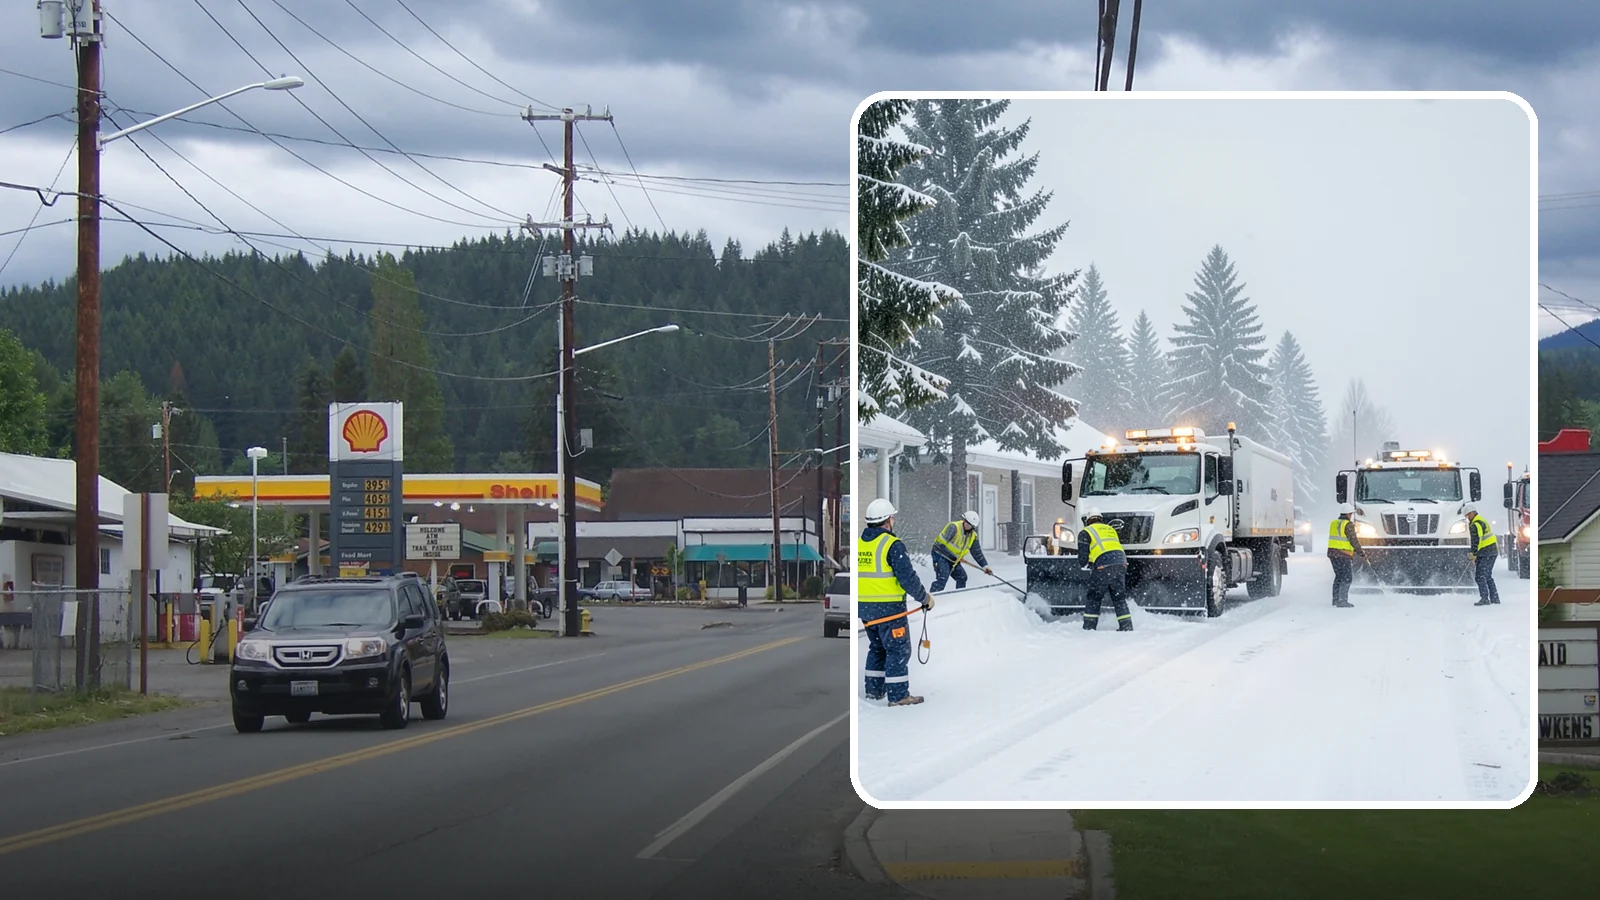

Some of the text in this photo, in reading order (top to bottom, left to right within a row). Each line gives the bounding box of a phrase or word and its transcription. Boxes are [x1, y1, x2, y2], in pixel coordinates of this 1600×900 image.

[366, 480, 383, 490] 395
[490, 484, 547, 499] Shell
[366, 494, 383, 504] 405
[366, 508, 383, 518] 415
[366, 522, 383, 532] 429
